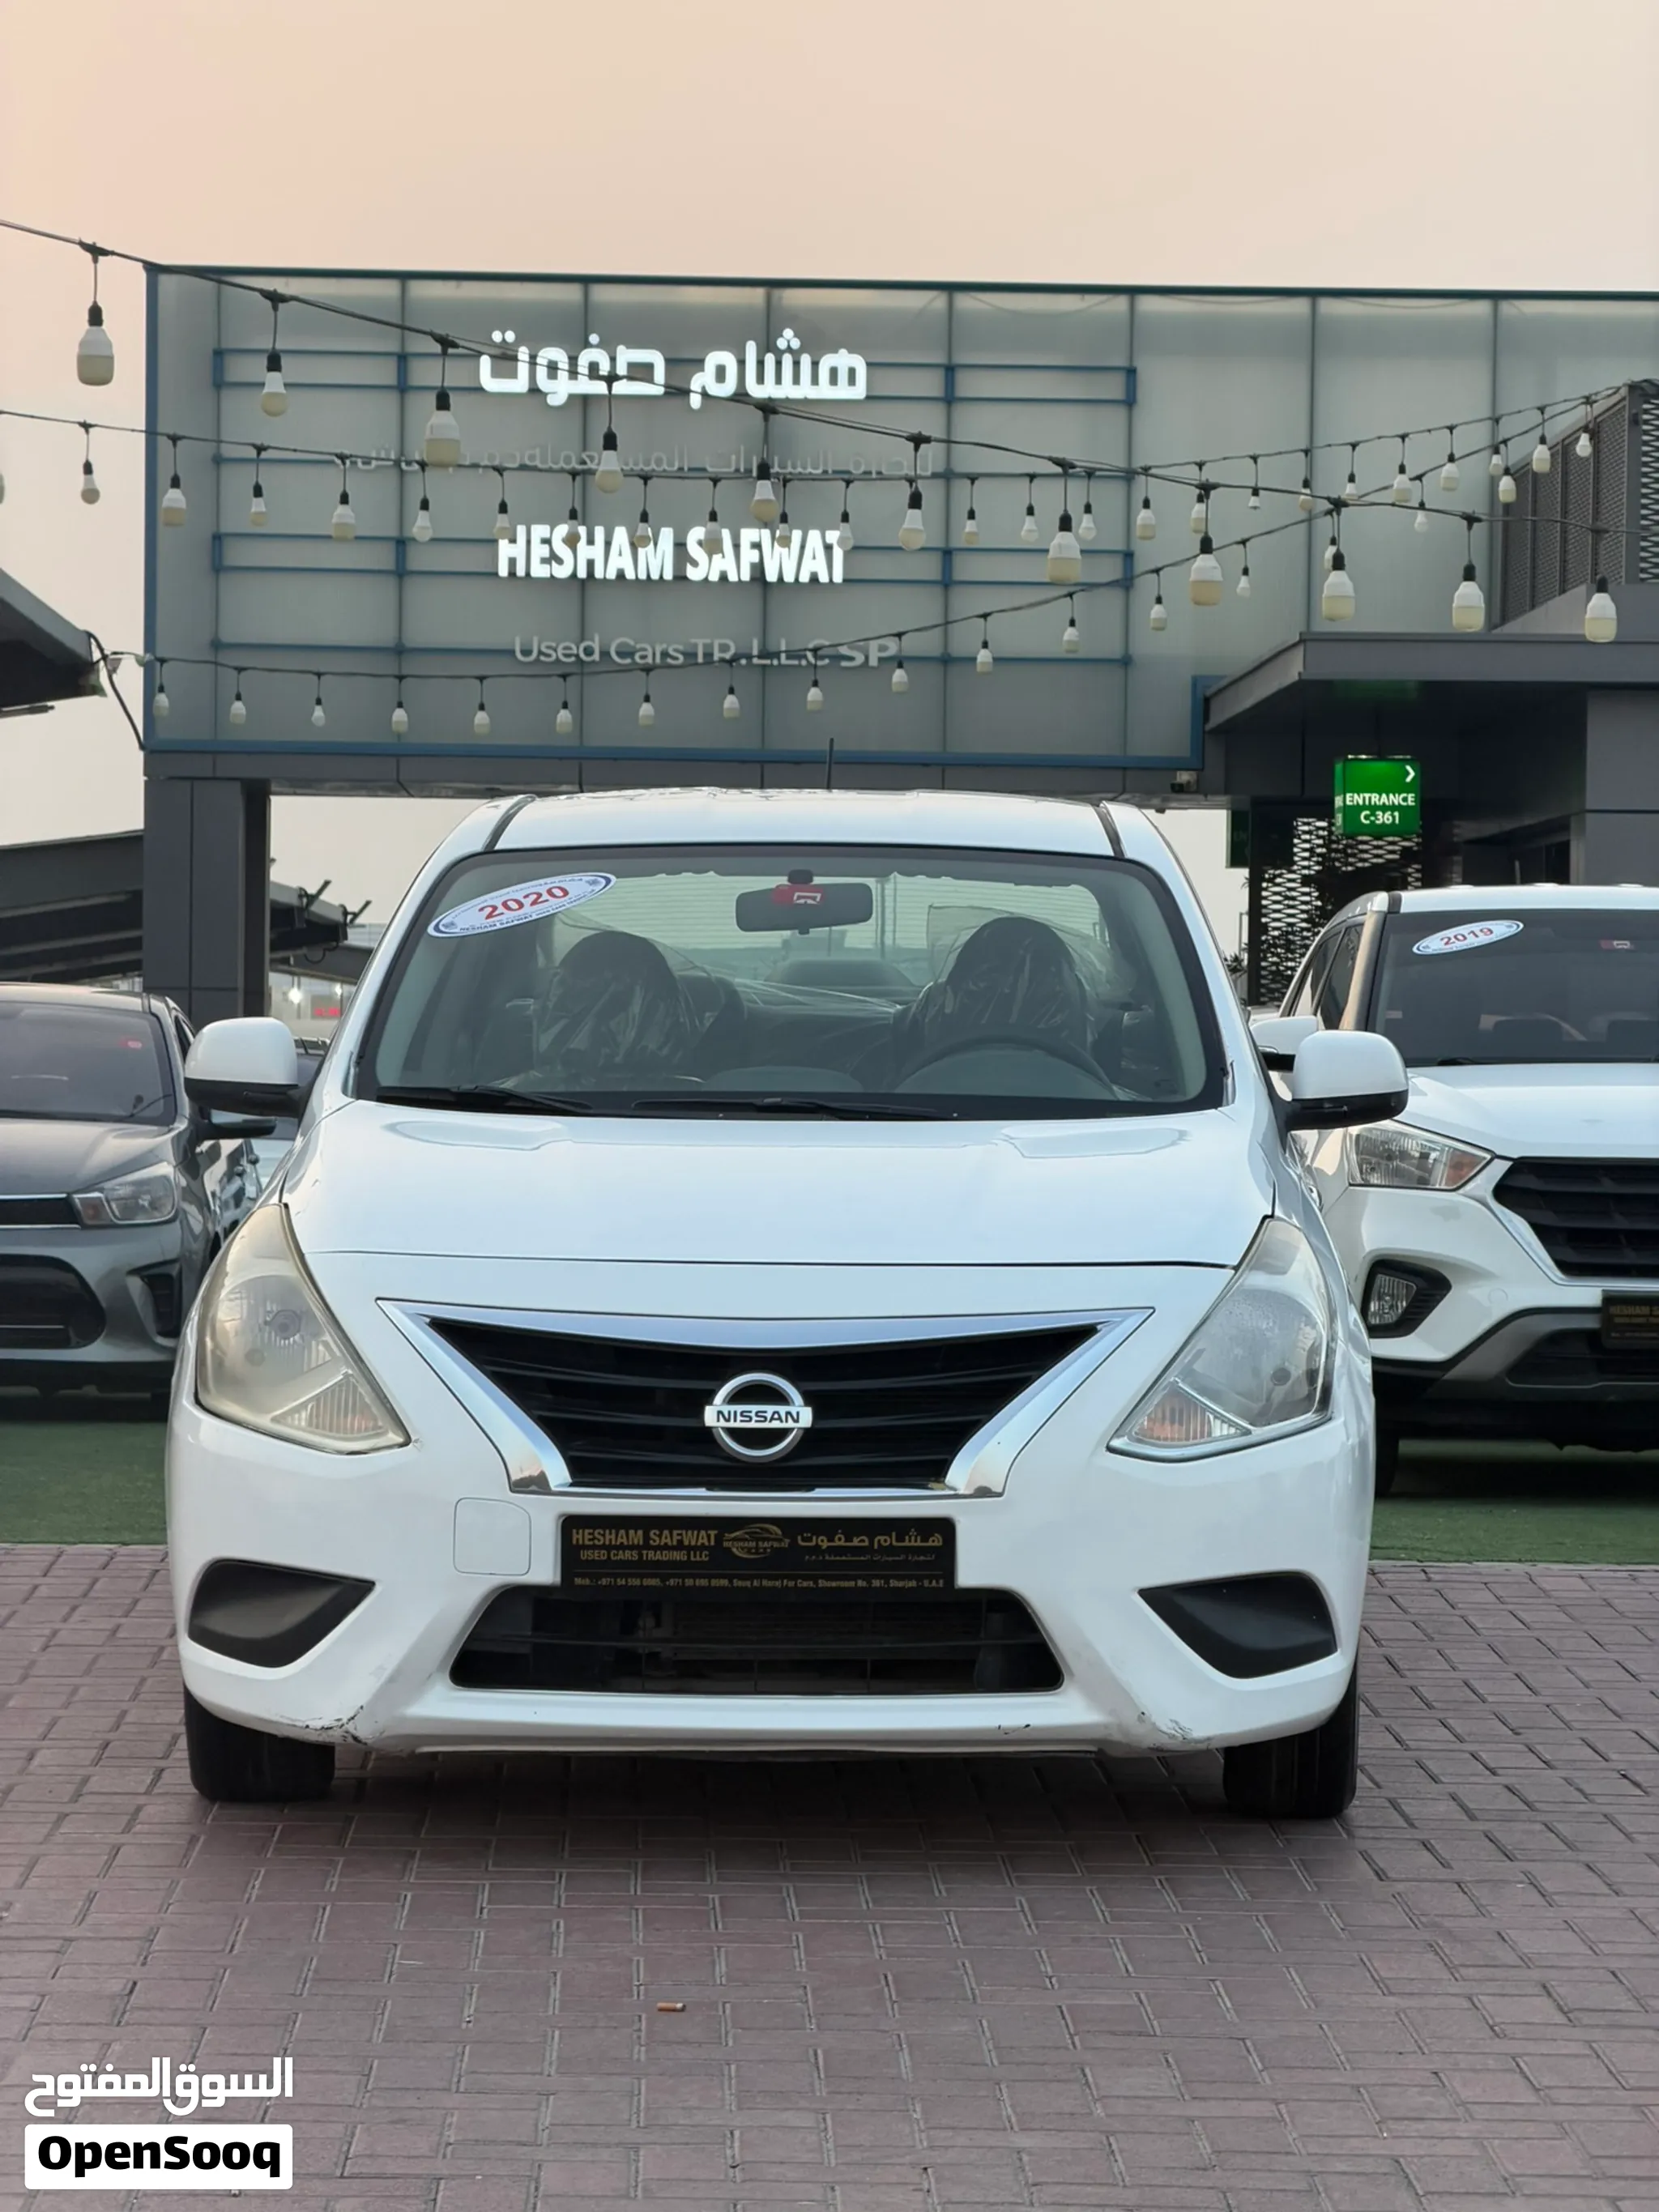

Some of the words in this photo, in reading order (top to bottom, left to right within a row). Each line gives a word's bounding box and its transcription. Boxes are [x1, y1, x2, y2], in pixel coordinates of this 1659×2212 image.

[479, 330, 666, 407] صفوت
[689, 327, 868, 411] هشام
[497, 523, 674, 581] HESHAM
[685, 526, 848, 584] SAFWAT
[514, 633, 600, 663] Used
[609, 637, 684, 664] Cars
[1346, 793, 1416, 806] ENTRANCE
[1360, 811, 1400, 825] C-361
[477, 885, 569, 920] 2020
[1440, 927, 1494, 946] 2019
[716, 1410, 800, 1424] NISSAN
[572, 1528, 644, 1545] HESHAM
[649, 1529, 719, 1546] SAFWAT
[797, 1529, 870, 1549] صفوت
[873, 1528, 944, 1549] هشام
[580, 1549, 608, 1560] USED
[610, 1549, 639, 1560] CARS
[642, 1549, 688, 1561] TRADING
[690, 1550, 710, 1561] LLC
